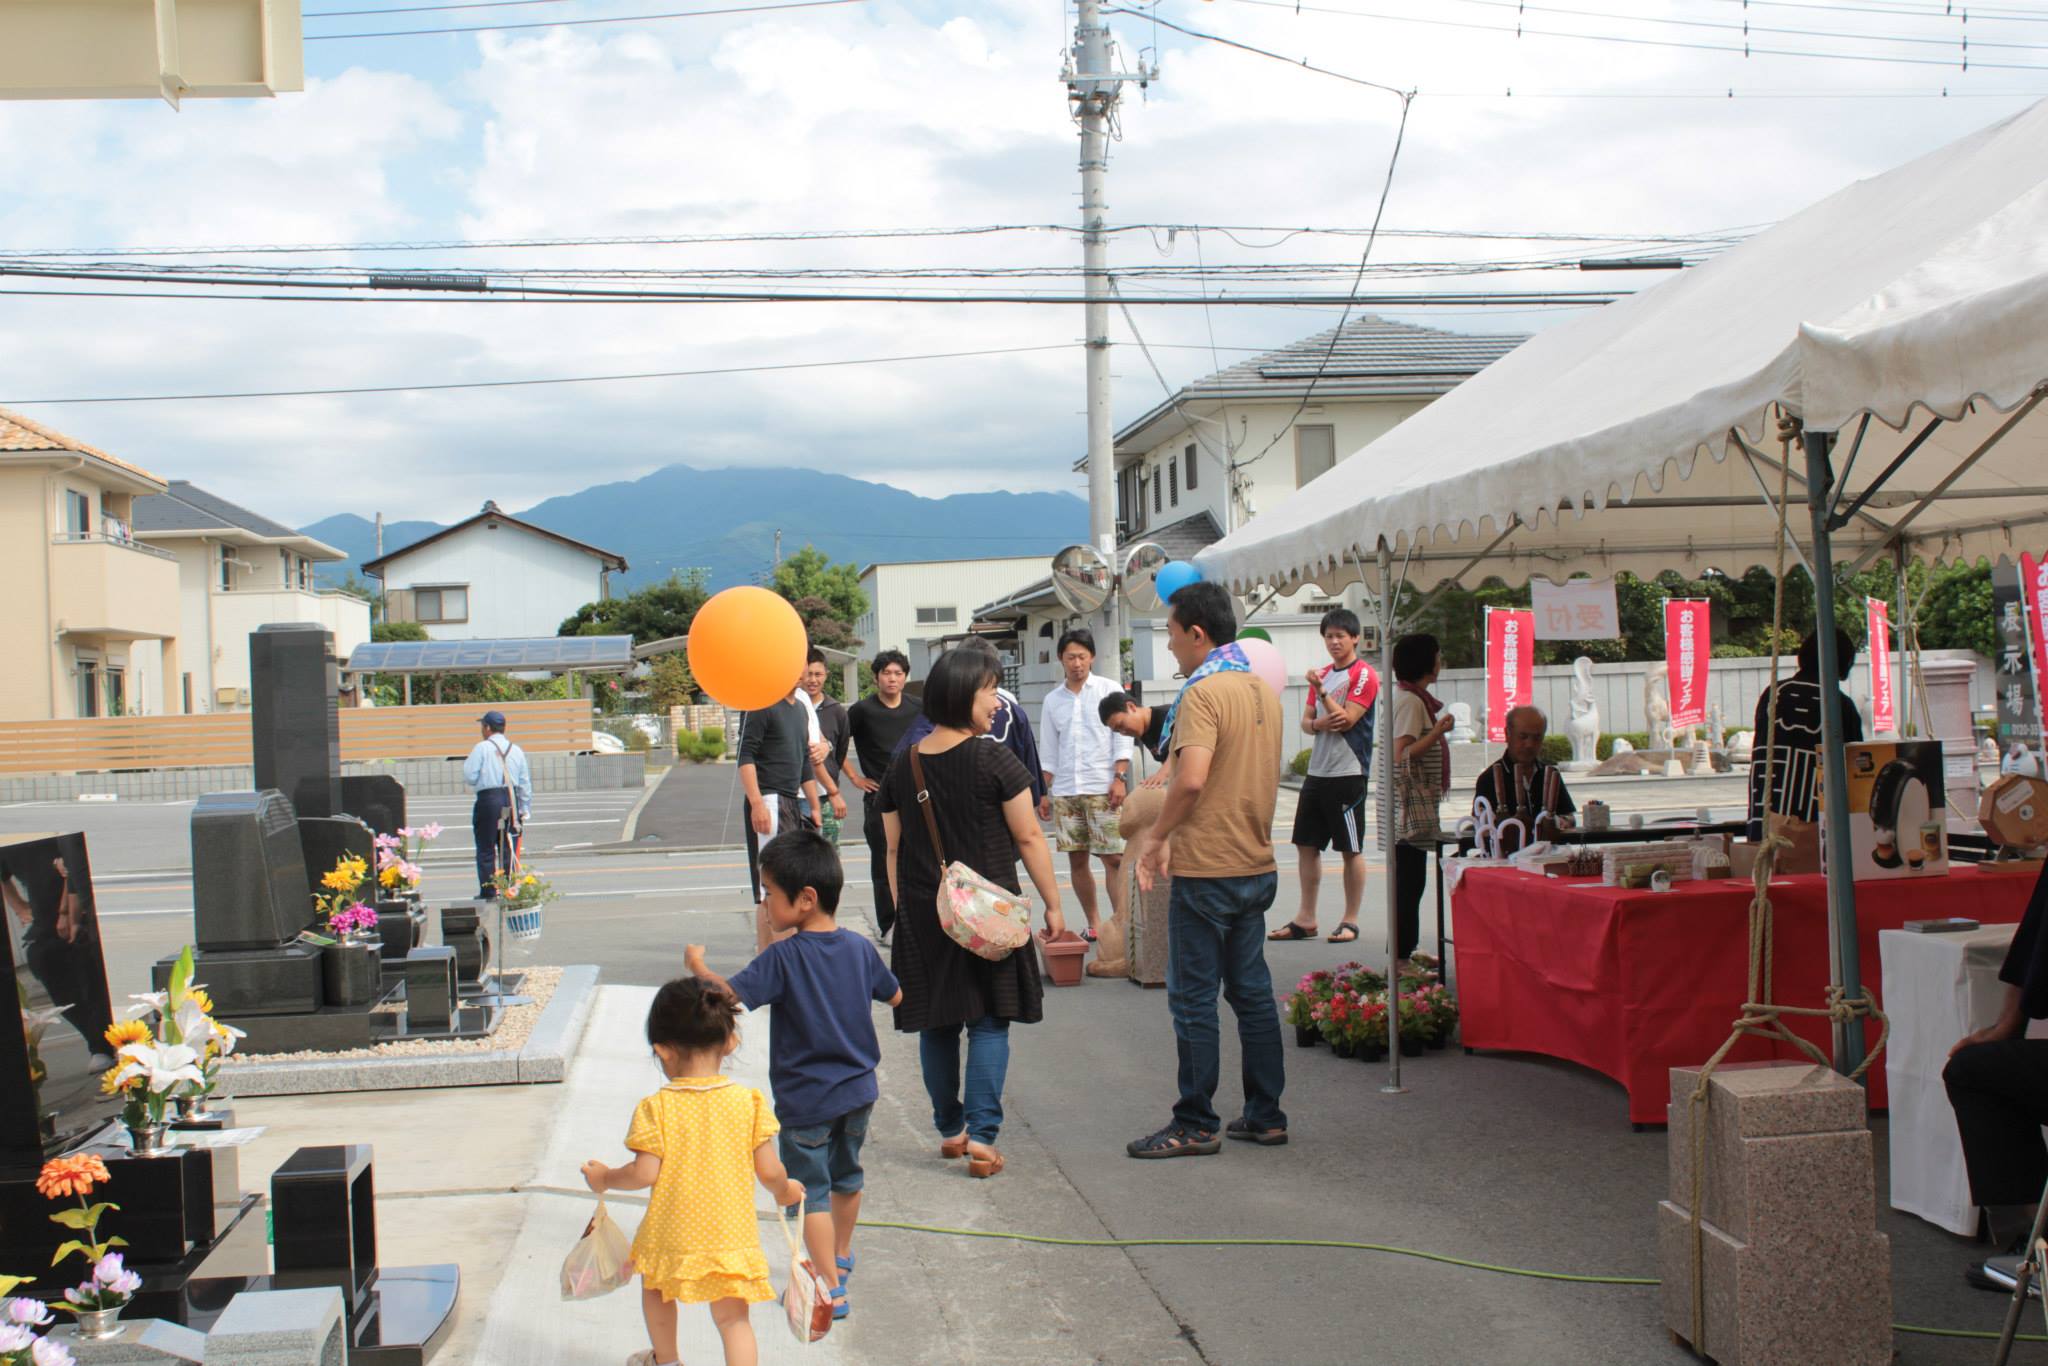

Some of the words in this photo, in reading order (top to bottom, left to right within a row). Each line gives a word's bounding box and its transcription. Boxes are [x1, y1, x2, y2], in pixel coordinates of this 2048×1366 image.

[1504, 620, 1518, 715] お客様感謝フェ
[2002, 602, 2023, 716] 展示場
